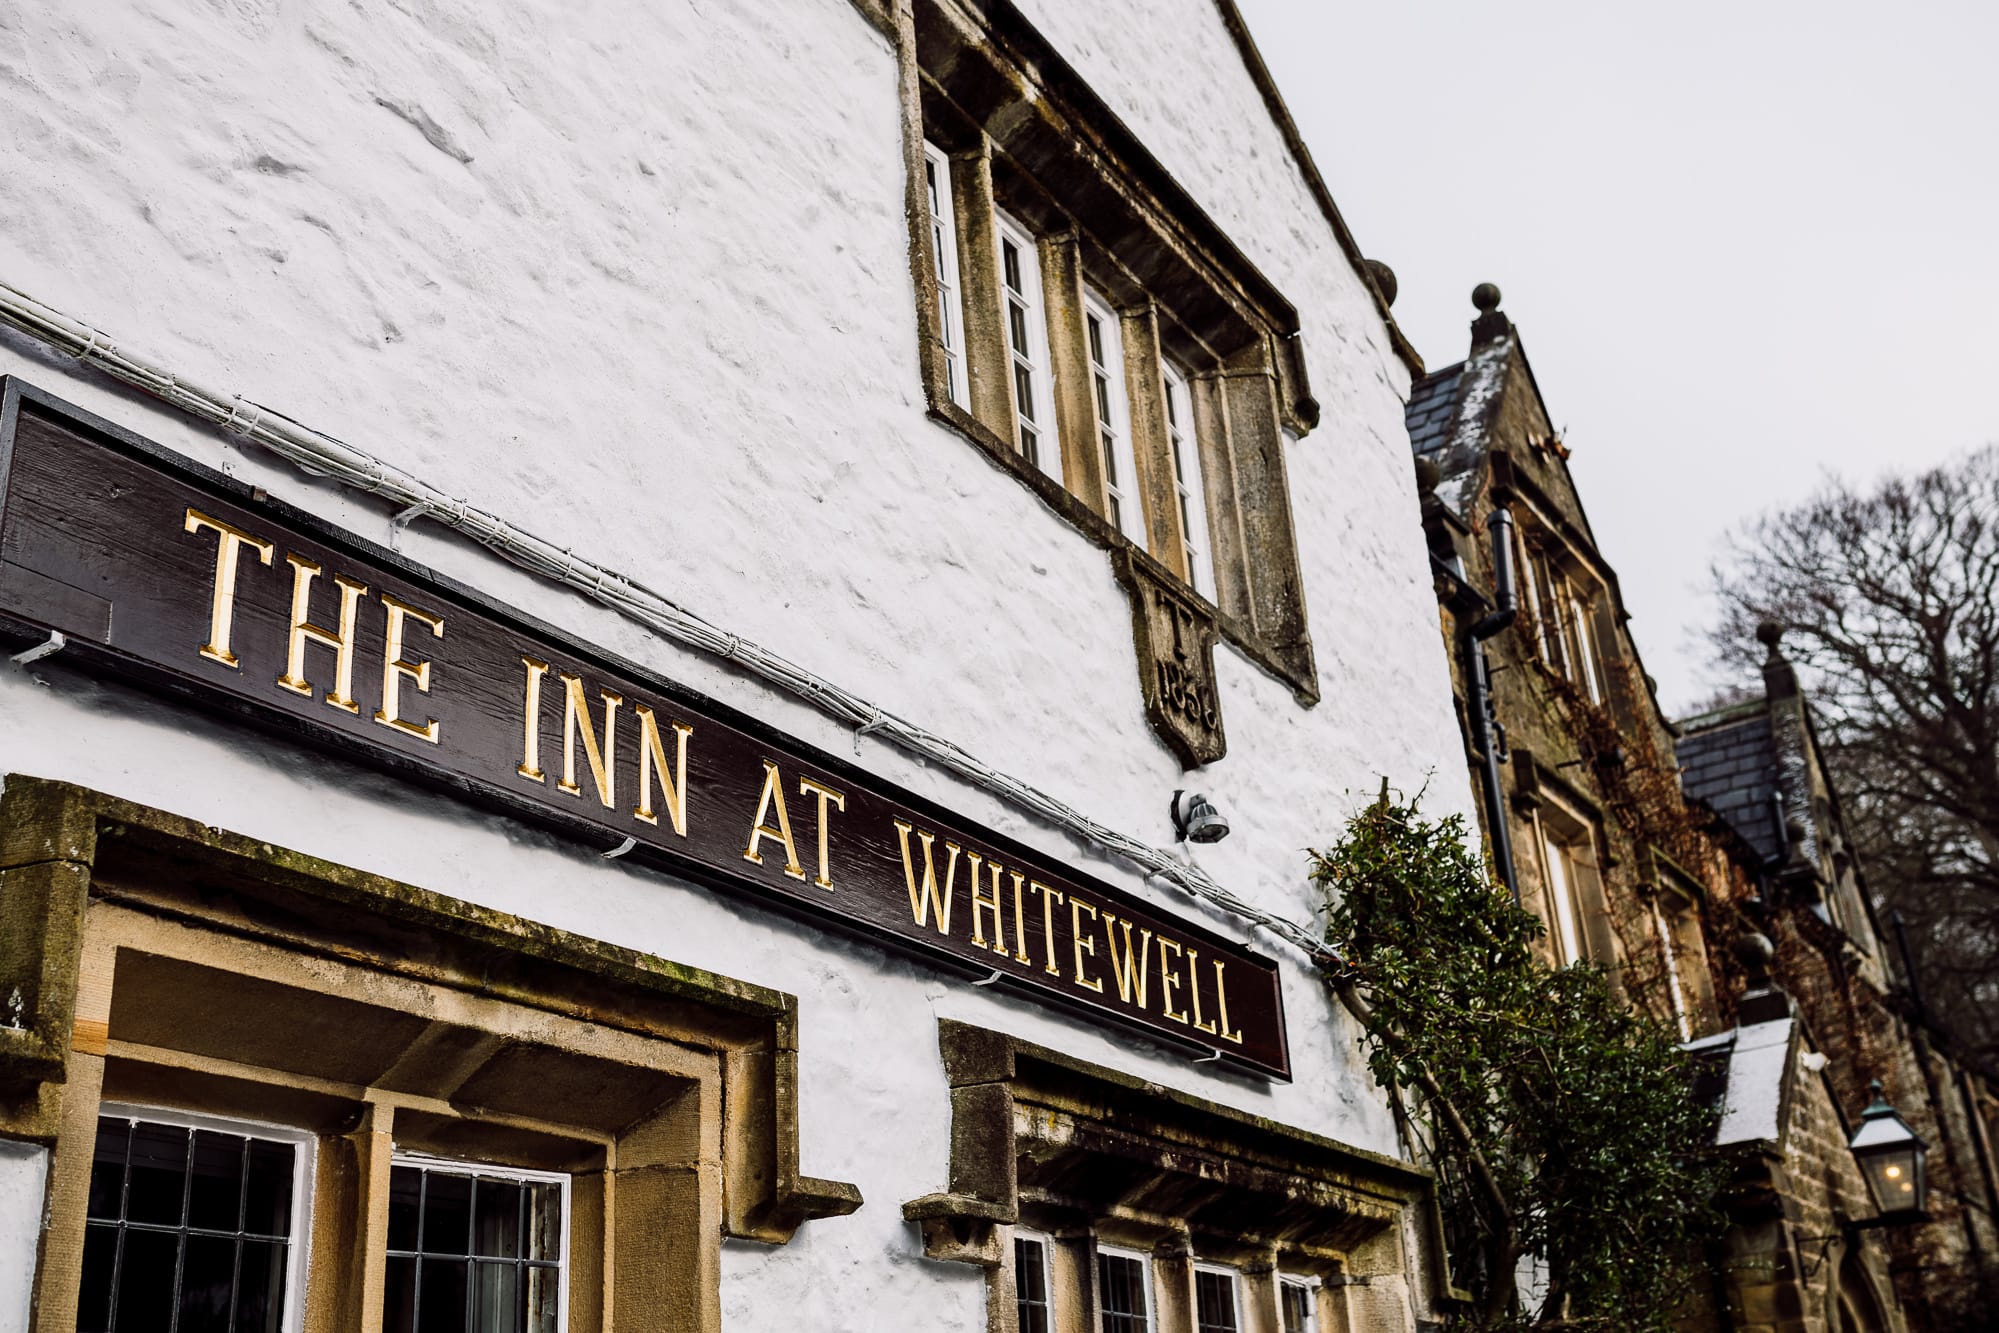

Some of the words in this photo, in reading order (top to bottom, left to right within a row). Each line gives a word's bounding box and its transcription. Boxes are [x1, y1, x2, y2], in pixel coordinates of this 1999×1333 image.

[184, 507, 445, 744] THE
[517, 654, 694, 837] INN
[742, 761, 846, 892] AT
[893, 818, 1243, 1045] WHITEWELL
